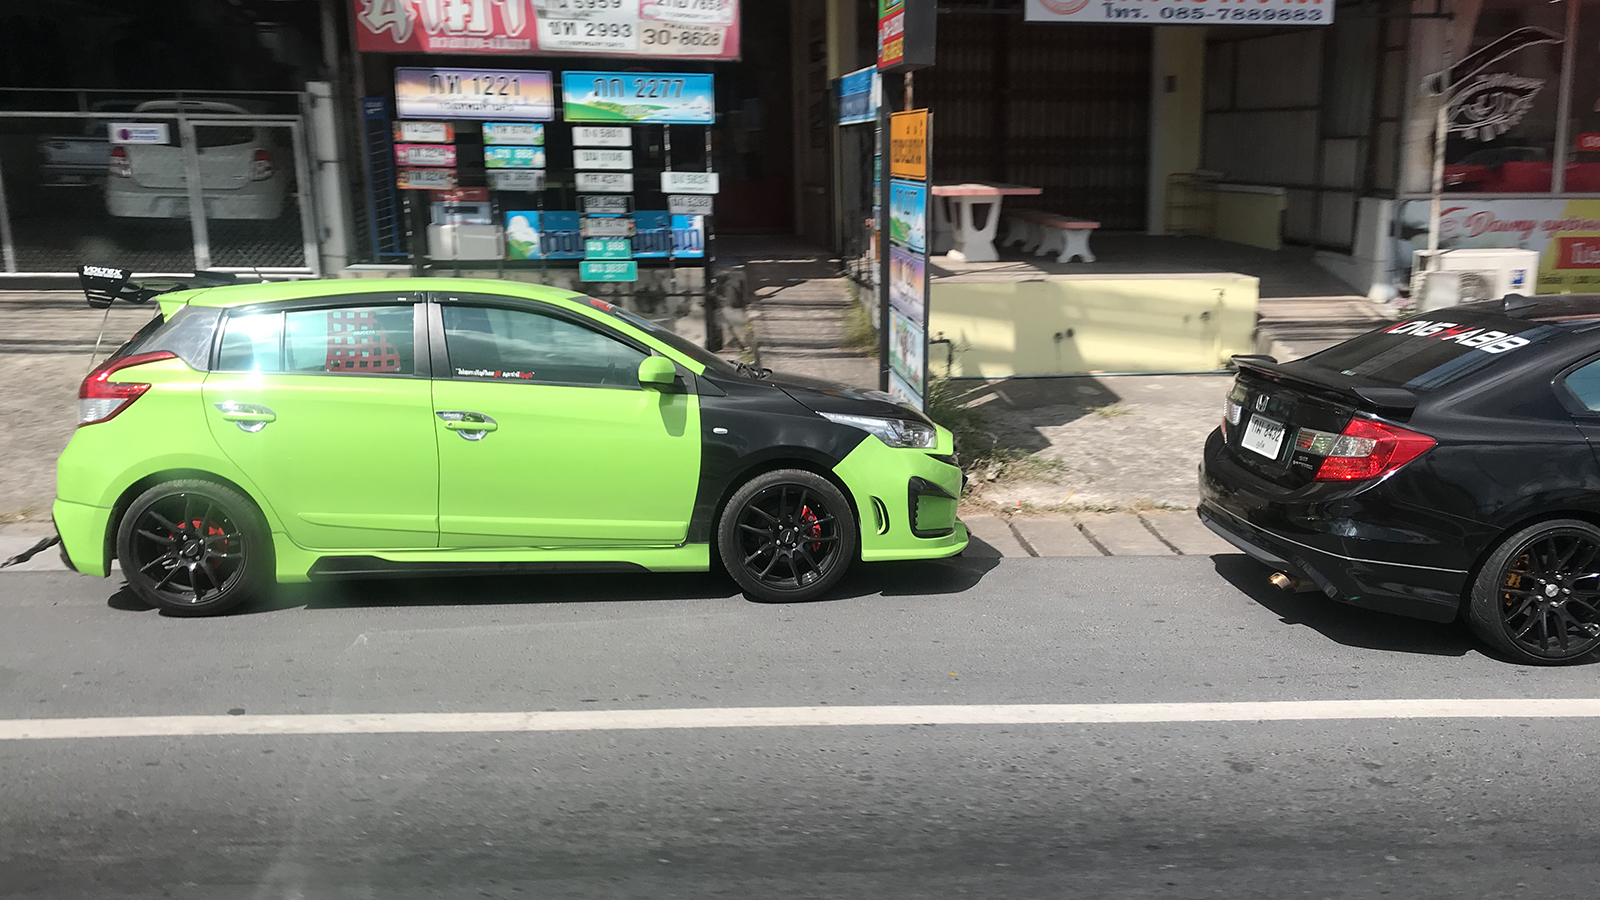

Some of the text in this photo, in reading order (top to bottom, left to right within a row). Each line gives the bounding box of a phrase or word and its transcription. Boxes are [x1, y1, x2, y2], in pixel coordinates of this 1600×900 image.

[585, 22, 633, 38] 2993
[642, 28, 721, 46] 30-8628
[472, 75, 520, 96] 1221
[634, 78, 684, 98] 2277
[84, 265, 122, 276] VOLTEX
